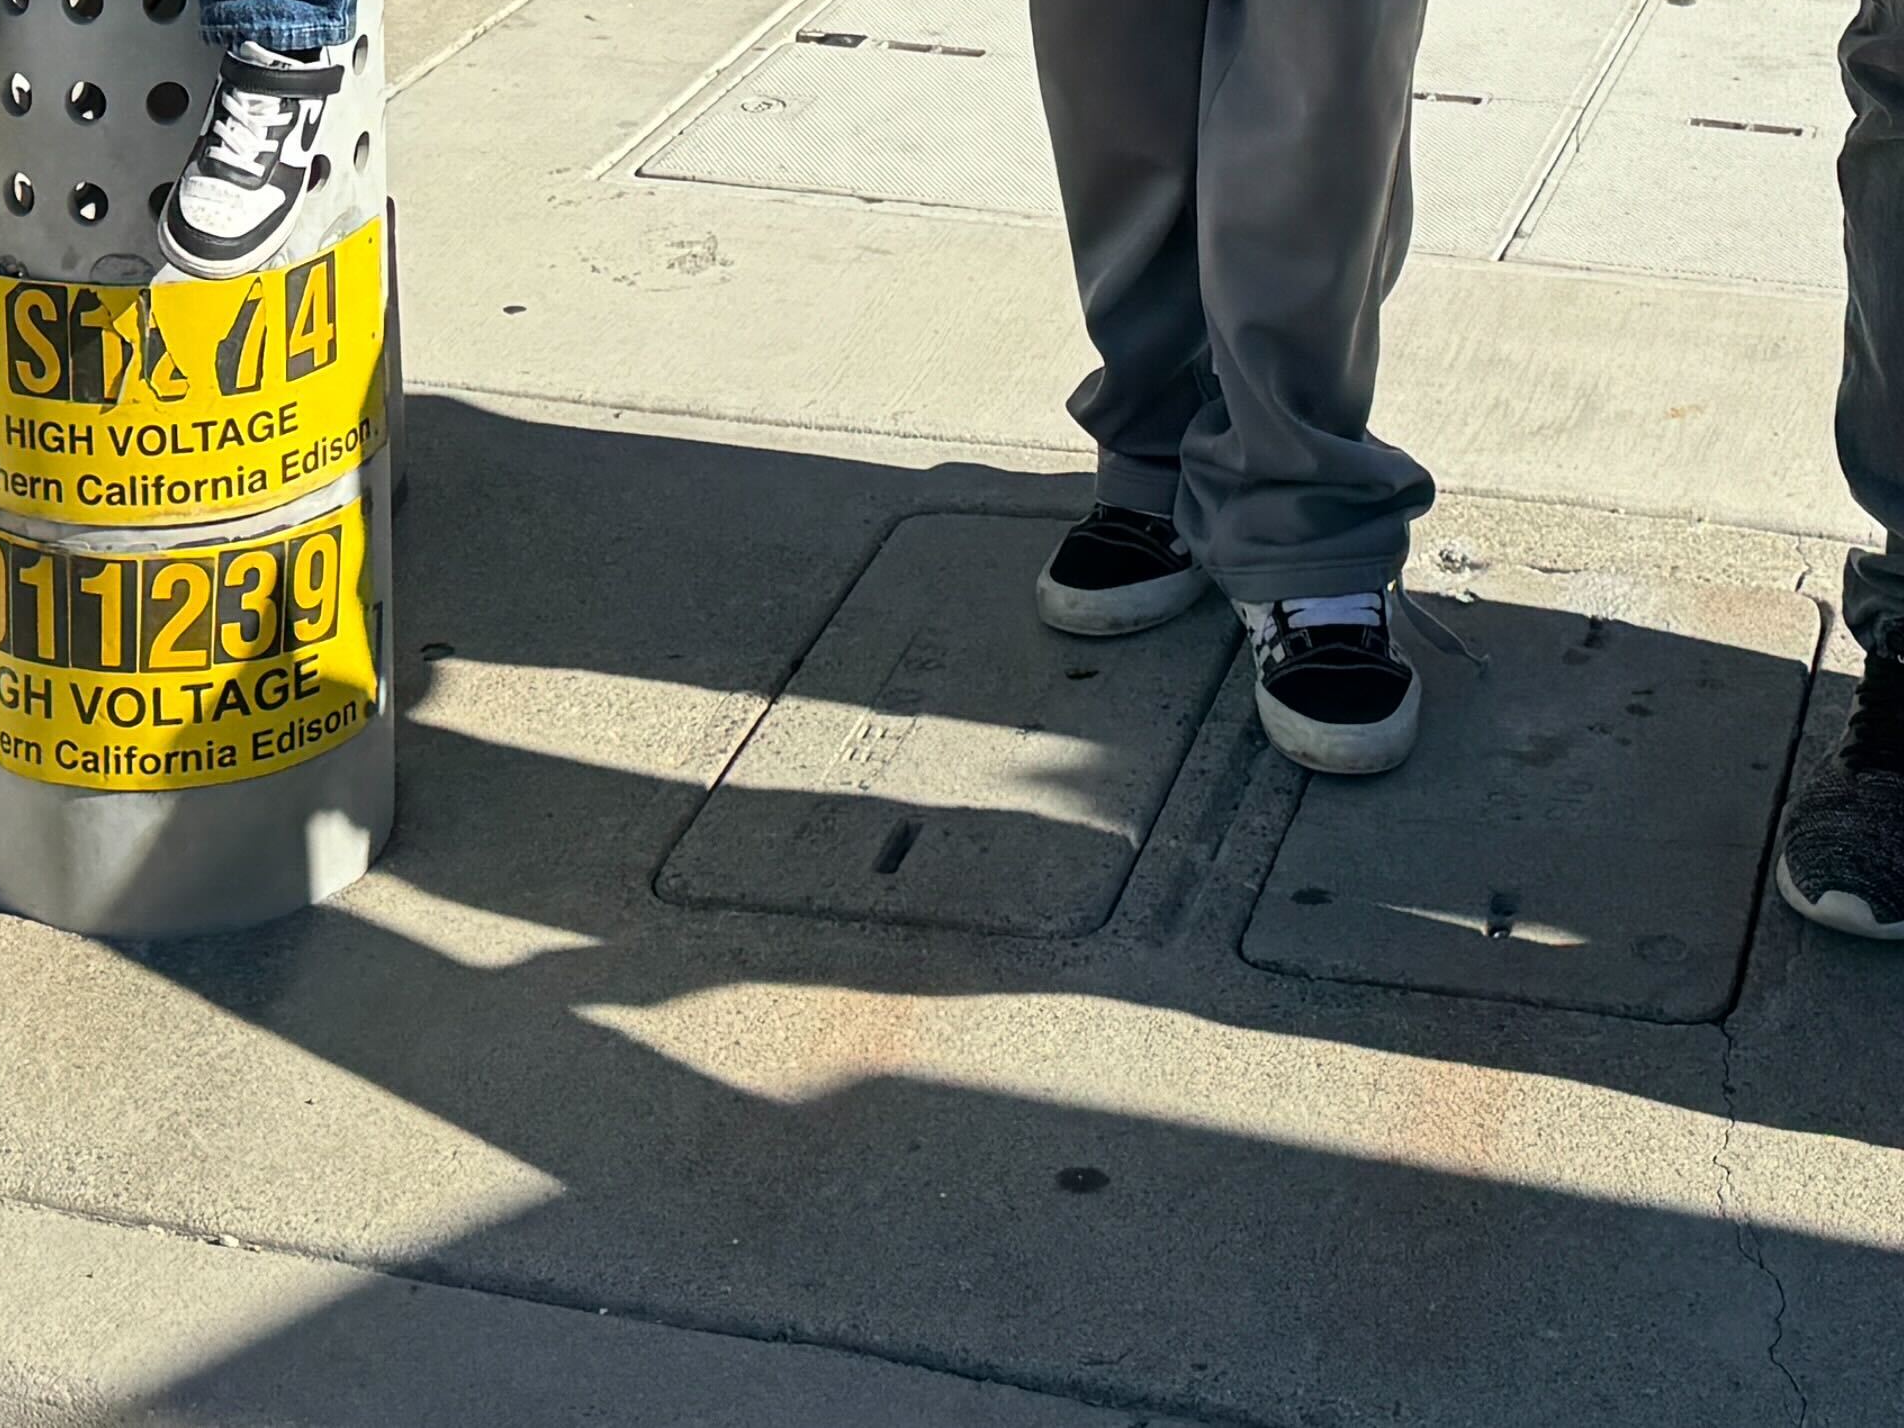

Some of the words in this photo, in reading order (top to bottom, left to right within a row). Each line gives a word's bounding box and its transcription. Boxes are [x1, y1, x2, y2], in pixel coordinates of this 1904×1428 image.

[6, 413, 94, 457] HIGH
[108, 401, 299, 458] VOLTAGE
[77, 465, 268, 507] California
[70, 653, 322, 729] VOLTAGE
[54, 739, 238, 776] California
[252, 699, 357, 763] Edison
